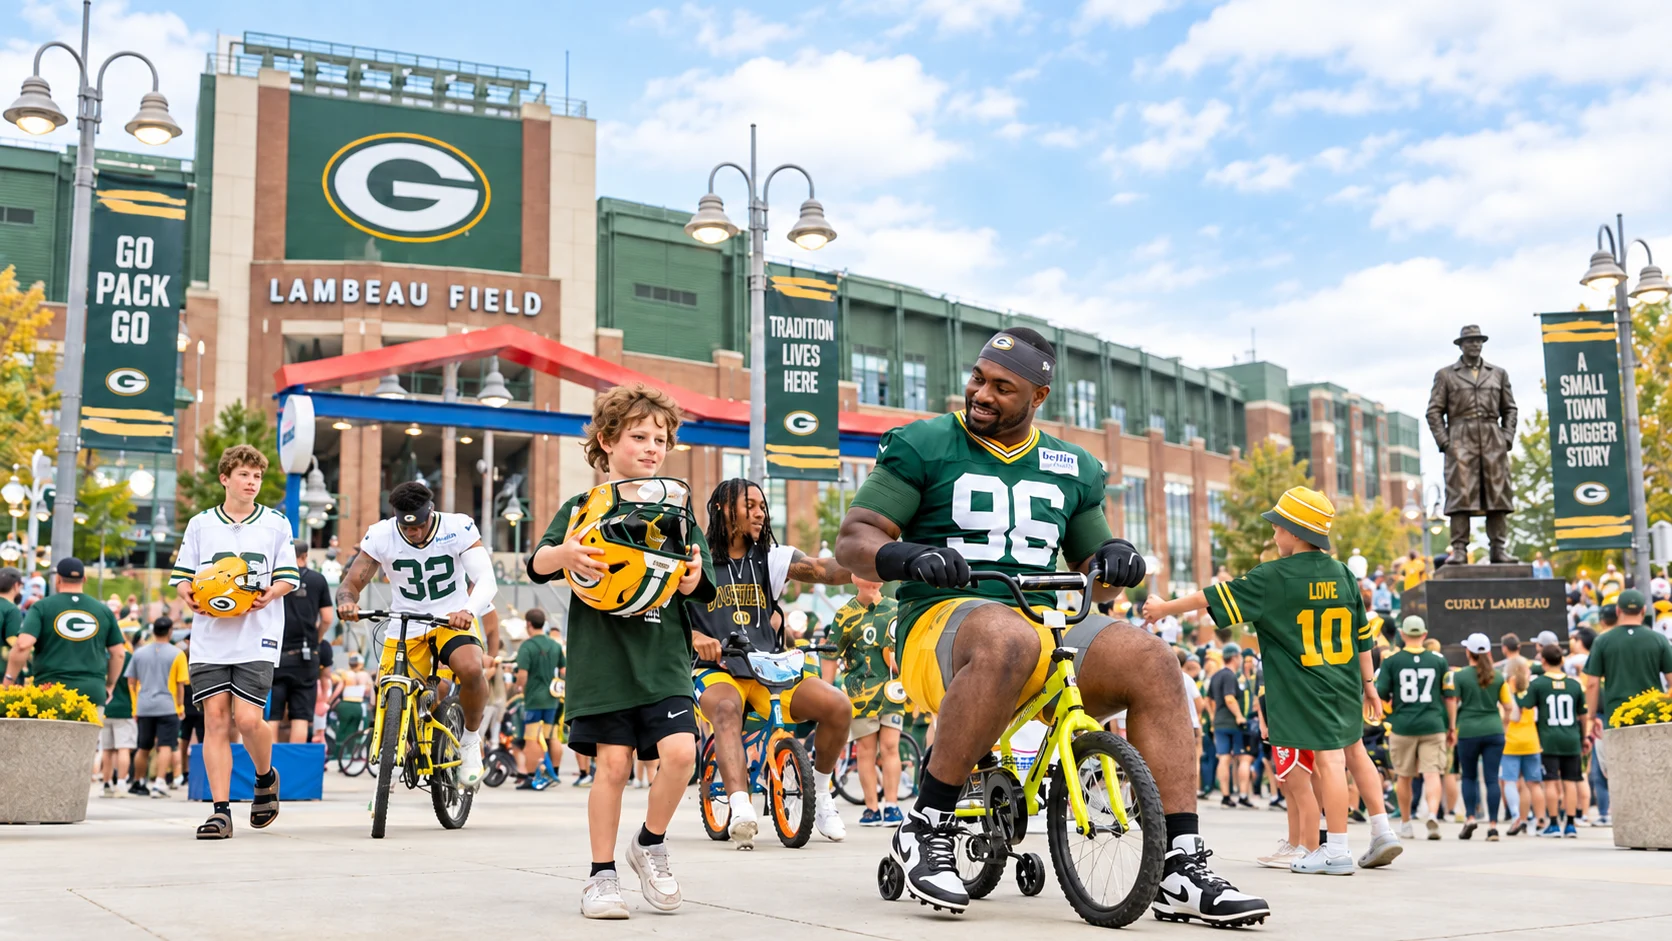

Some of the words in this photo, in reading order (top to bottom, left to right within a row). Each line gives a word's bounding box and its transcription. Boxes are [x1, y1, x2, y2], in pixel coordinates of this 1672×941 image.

[334, 142, 480, 232] G
[115, 235, 154, 269] GO
[95, 271, 171, 308] PACK
[269, 277, 429, 307] LAMBEAU
[449, 284, 543, 316] FIELD
[110, 310, 150, 345] GO
[769, 315, 835, 341] TRADITION
[782, 343, 821, 367] LIVES
[1577, 351, 1588, 373] A
[783, 370, 819, 394] HERE
[1560, 373, 1608, 396] SMALL
[1563, 397, 1607, 420] TOWN
[1558, 423, 1569, 445] A
[1570, 421, 1617, 444] BIGGER
[1042, 451, 1074, 464] bellin
[1566, 445, 1611, 468] STORY
[946, 472, 1066, 567] 96
[391, 553, 457, 602] 32
[1308, 581, 1339, 601] LOVE
[1444, 598, 1487, 611] CURLY
[1489, 597, 1551, 610] LAMBEAU
[1296, 607, 1354, 667] 10
[1399, 668, 1436, 703] 87
[1545, 694, 1575, 726] 10
